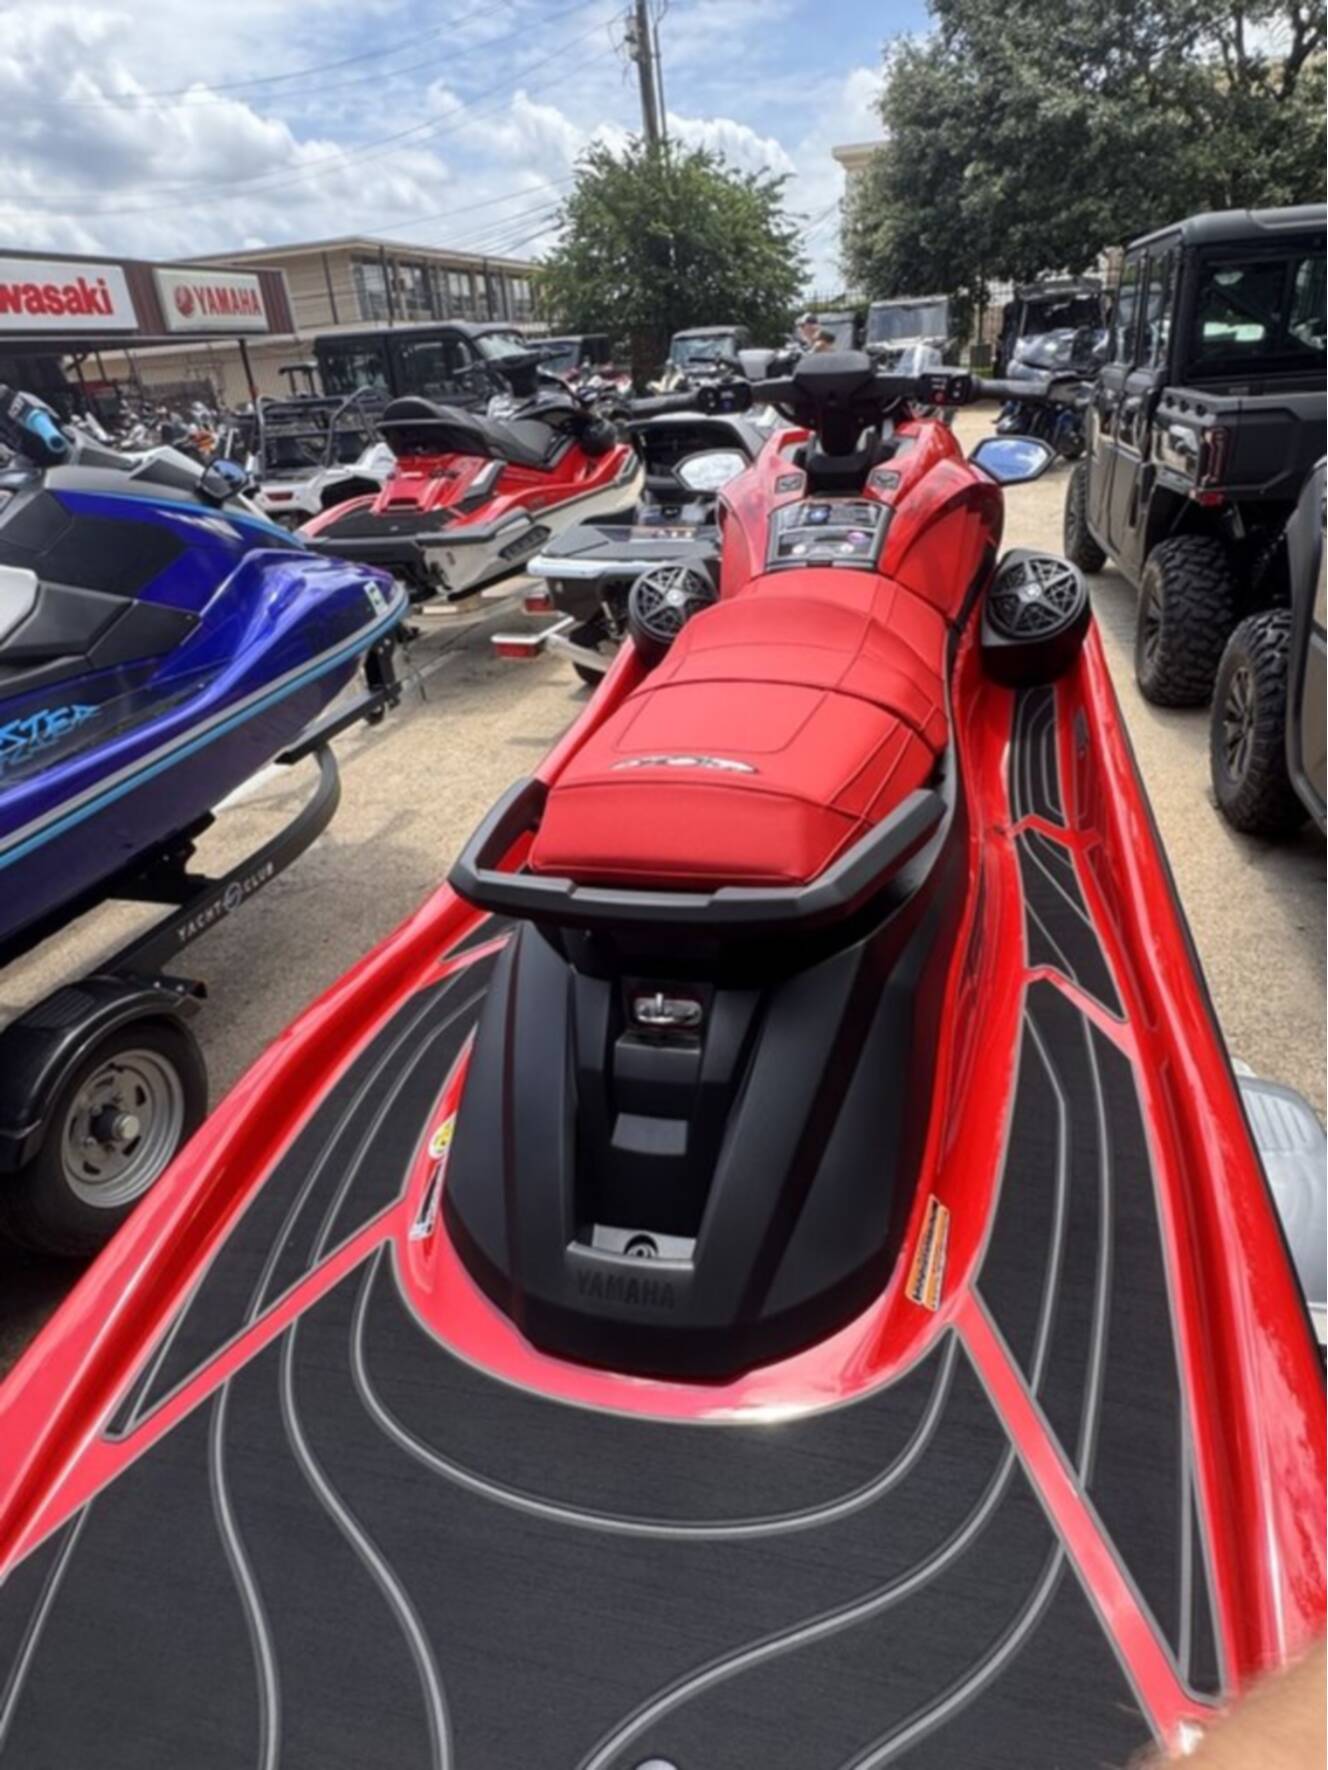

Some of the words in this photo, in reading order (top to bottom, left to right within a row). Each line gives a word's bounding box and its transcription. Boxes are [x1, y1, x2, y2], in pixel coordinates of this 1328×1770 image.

[193, 285, 263, 316] YAMAHA
[178, 898, 222, 941] YACHT
[243, 861, 274, 893] CLUB
[577, 1267, 676, 1311] YAMAHA
